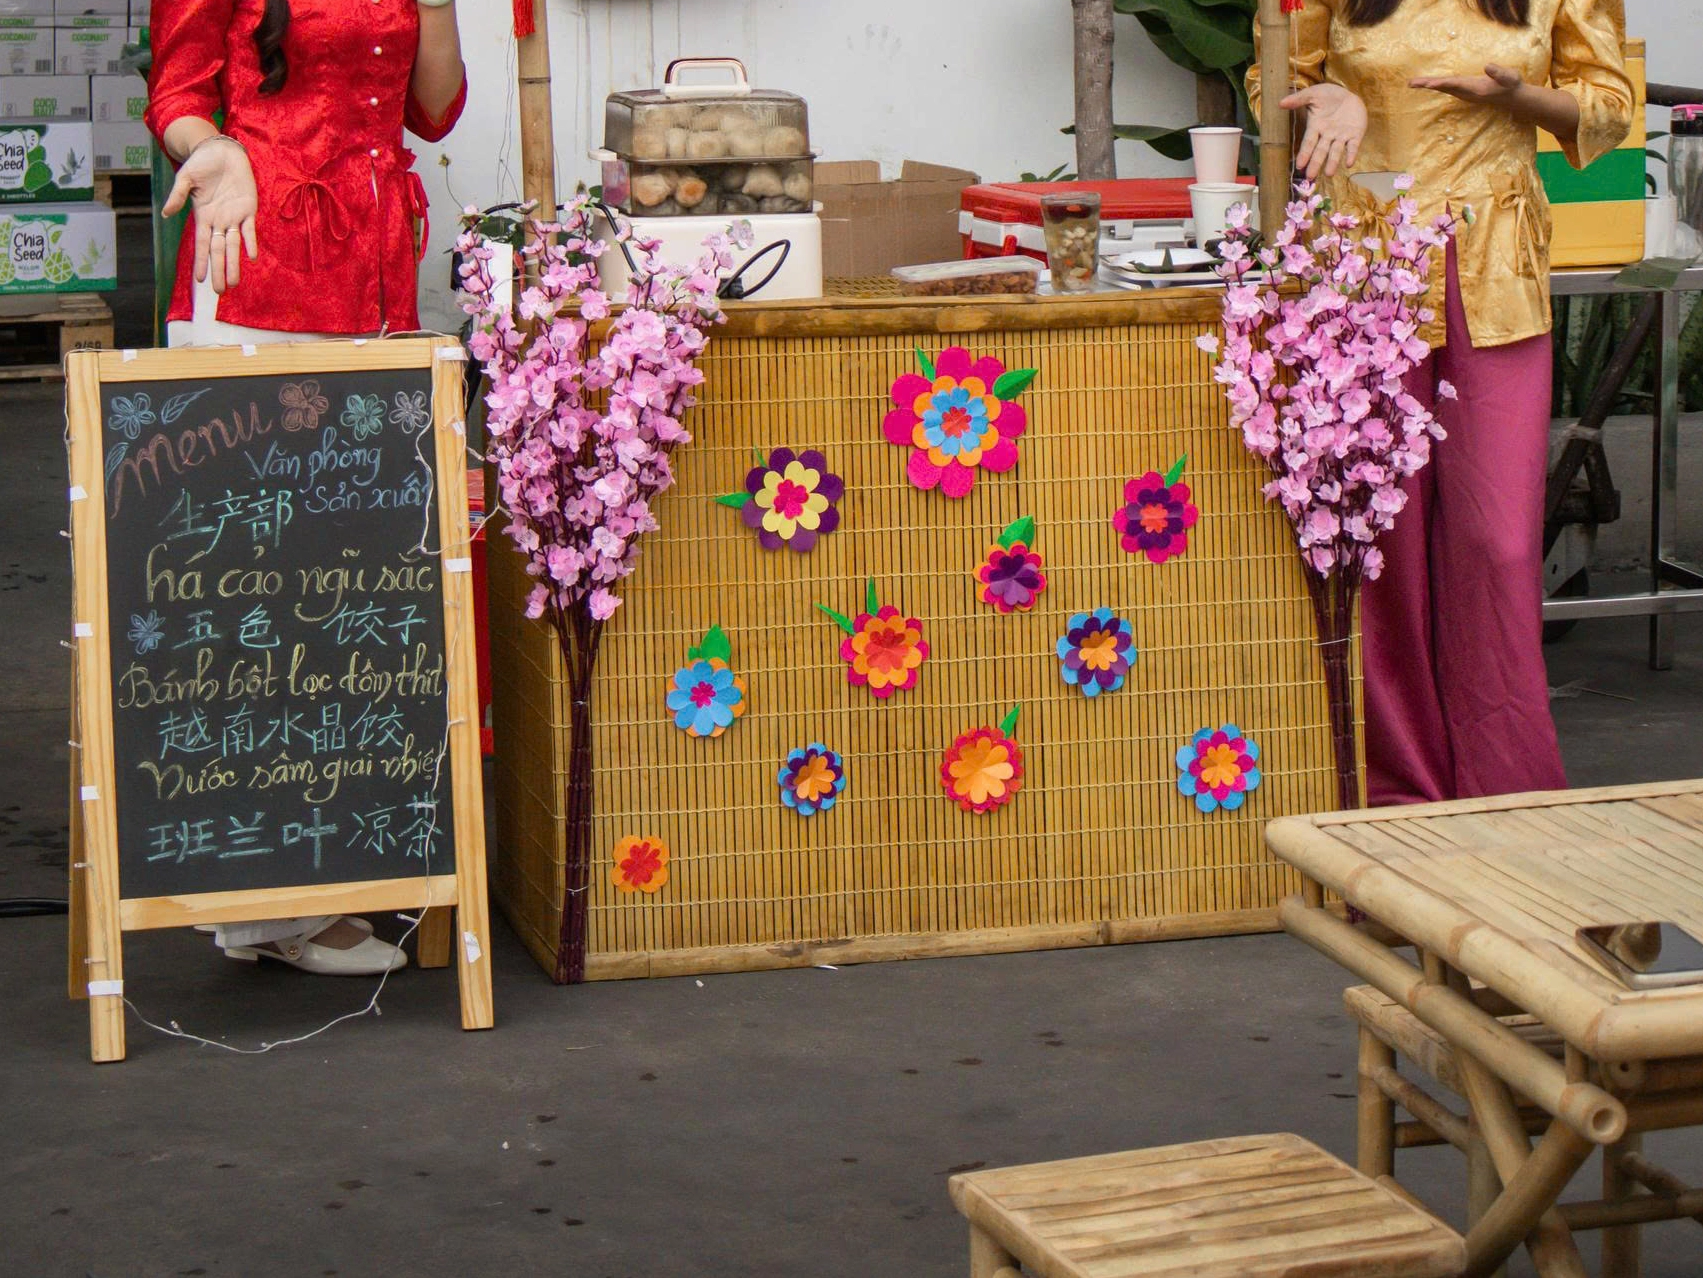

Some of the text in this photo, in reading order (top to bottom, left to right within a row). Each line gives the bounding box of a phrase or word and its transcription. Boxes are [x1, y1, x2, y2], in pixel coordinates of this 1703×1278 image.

[72, 33, 111, 41] COCONAUT
[73, 17, 110, 25] COCONAUT
[14, 233, 45, 248] Chia
[14, 248, 45, 262] Seed
[244, 426, 382, 493] Văn phòng
[158, 487, 293, 554] 生产部
[218, 545, 283, 598] cảo
[118, 642, 443, 709] Bánh bột lọc tôm thịt
[158, 702, 406, 760] 越南水晶饺
[247, 750, 318, 790] sâm
